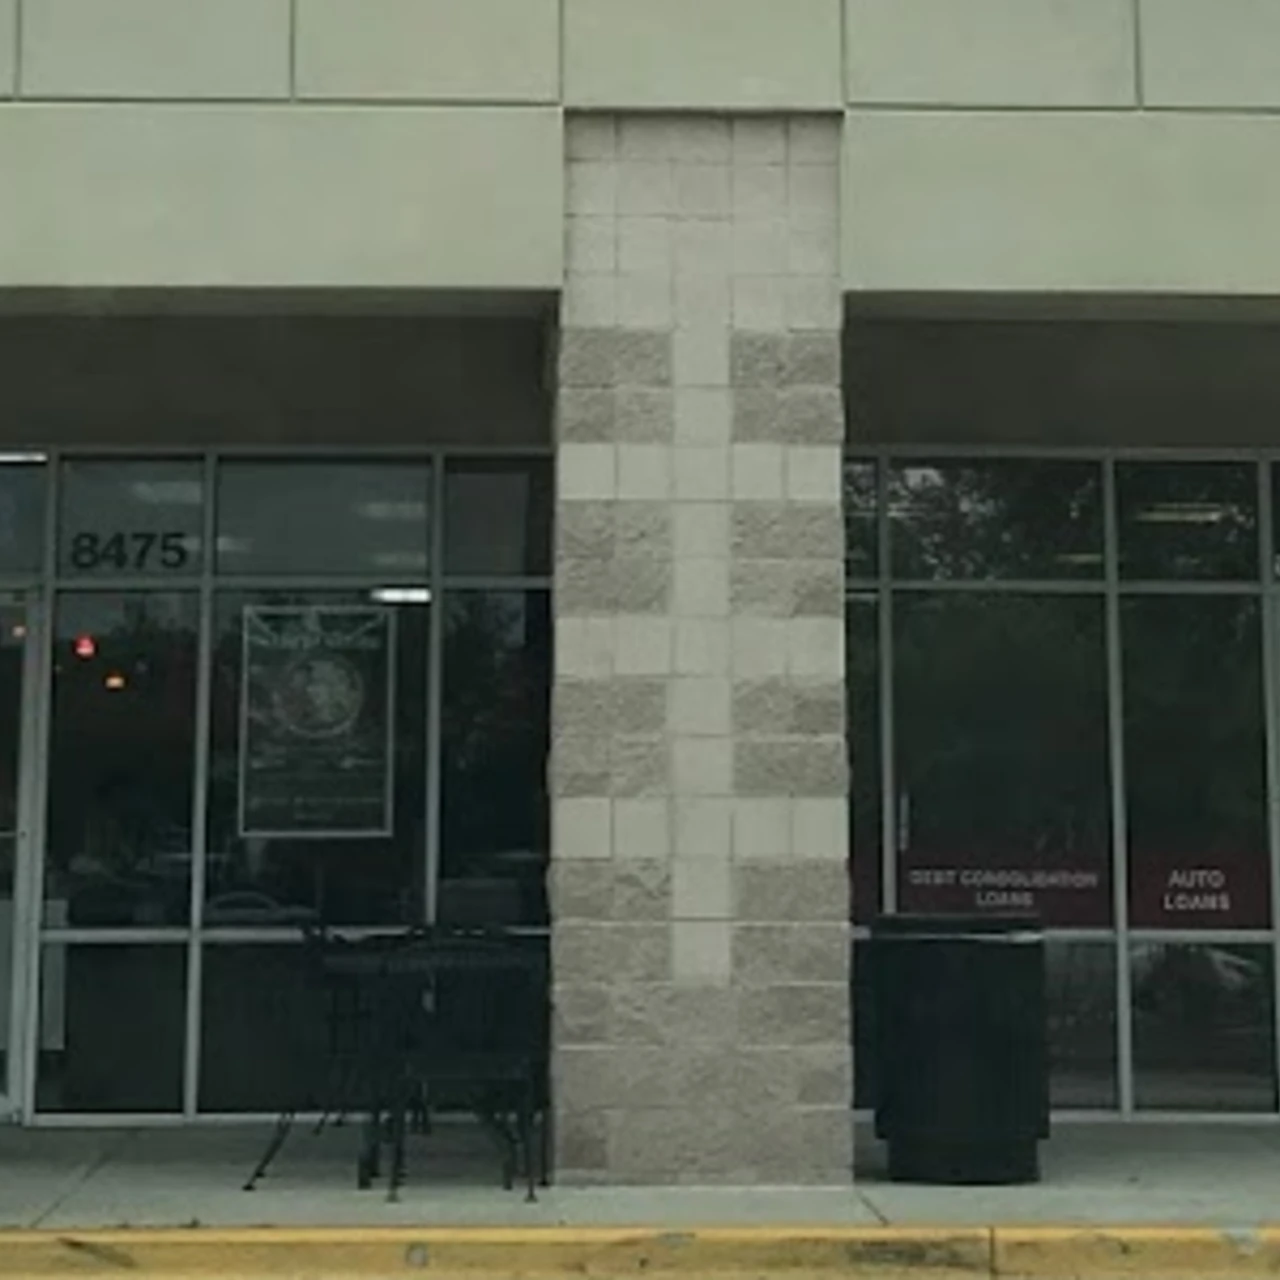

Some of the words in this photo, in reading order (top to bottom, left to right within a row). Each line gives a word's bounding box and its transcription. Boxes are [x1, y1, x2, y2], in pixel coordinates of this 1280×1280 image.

[71, 532, 188, 569] 8475
[908, 870, 956, 886] DEBT
[1168, 871, 1226, 889] AUTO
[976, 892, 1034, 908] LOANS
[1164, 894, 1231, 912] LOANS
